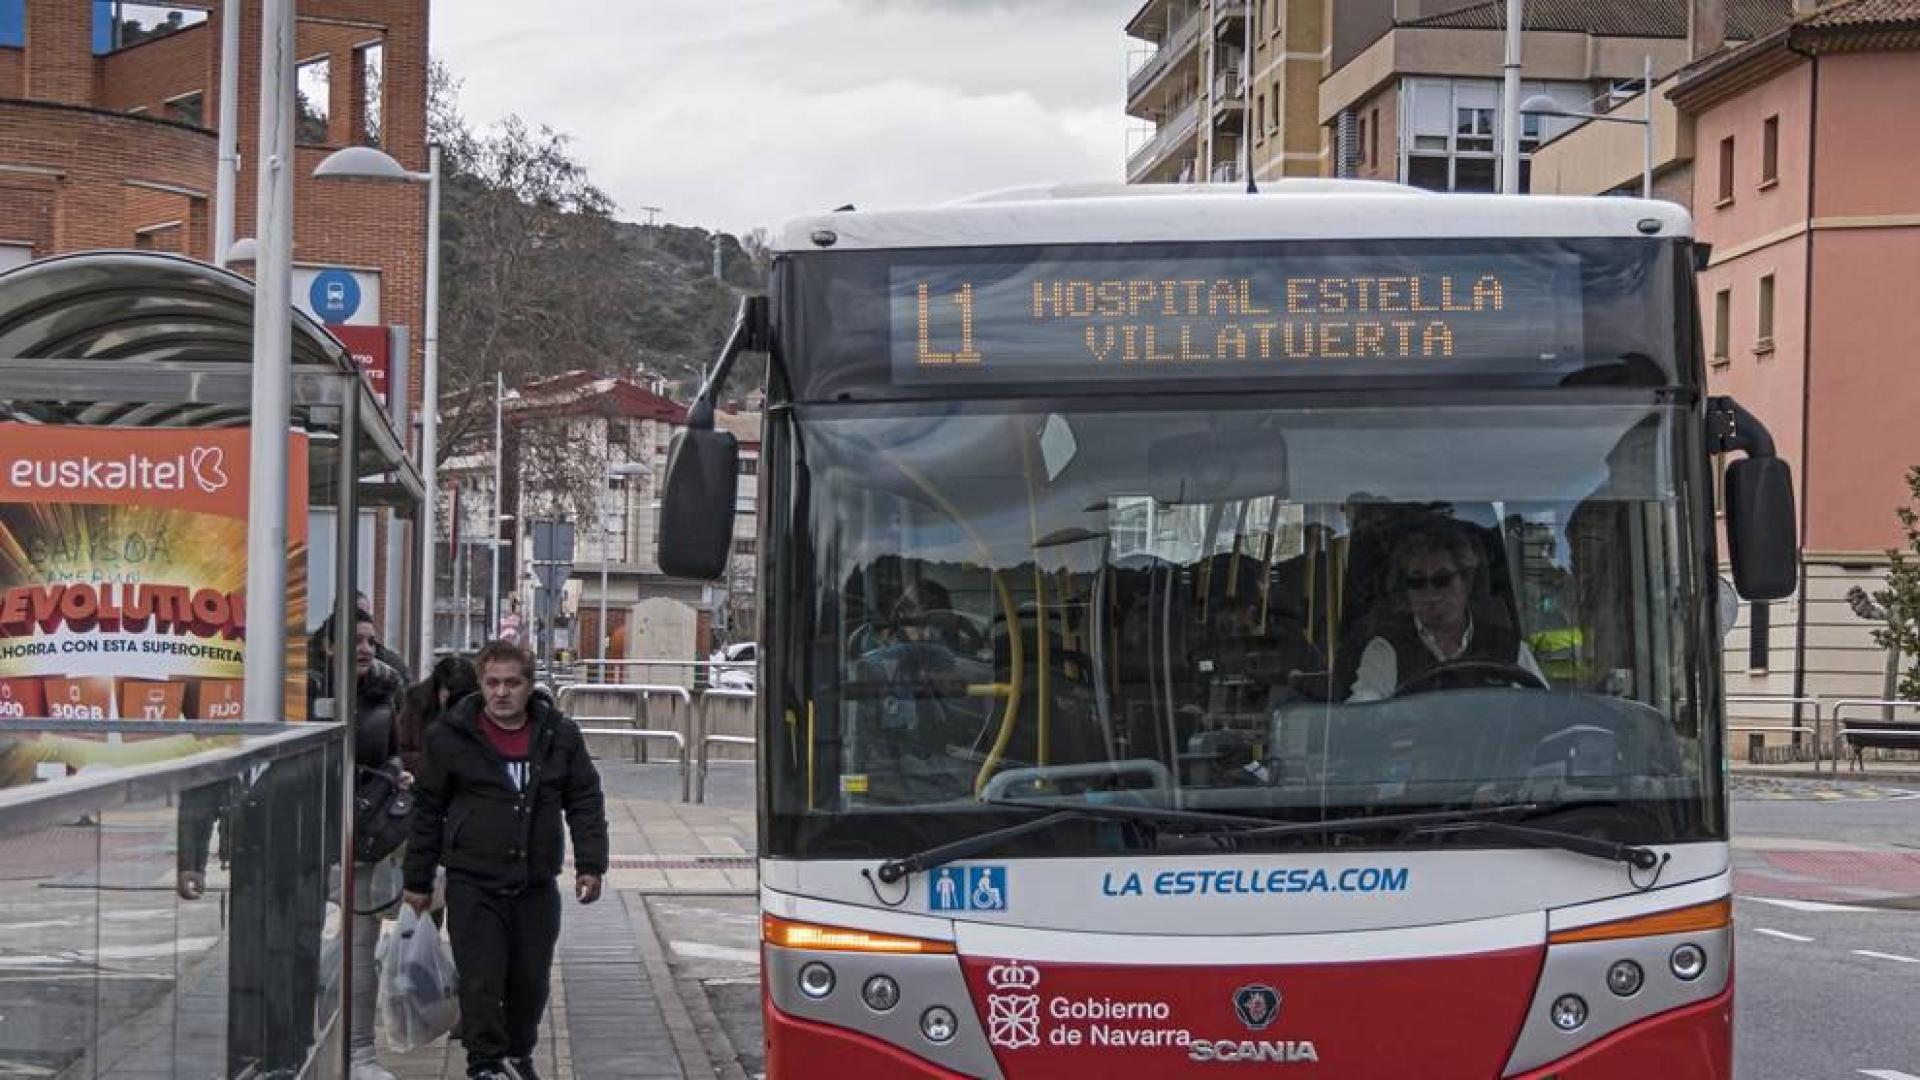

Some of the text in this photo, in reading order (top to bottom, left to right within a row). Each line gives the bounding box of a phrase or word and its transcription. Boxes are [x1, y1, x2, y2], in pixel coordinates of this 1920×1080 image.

[1033, 274, 1504, 317] HOSPITAL ESTELLA
[917, 280, 983, 365] L1
[1086, 320, 1455, 361] VILLATUERTA
[11, 454, 185, 490] euskaltel
[0, 584, 247, 638] EVOLUTIO
[62, 640, 98, 653] CON
[103, 640, 137, 653] ESTA
[143, 641, 244, 664] SUPEROFERTA
[51, 703, 104, 719] 30GB
[143, 705, 167, 719] TV
[209, 702, 241, 718] FIJO
[1102, 867, 1409, 896] LA ESTELLESA.COM
[1050, 996, 1170, 1019] Gobierno
[1050, 1024, 1190, 1046] de Navarra
[1188, 1039, 1320, 1061] SCANIA
